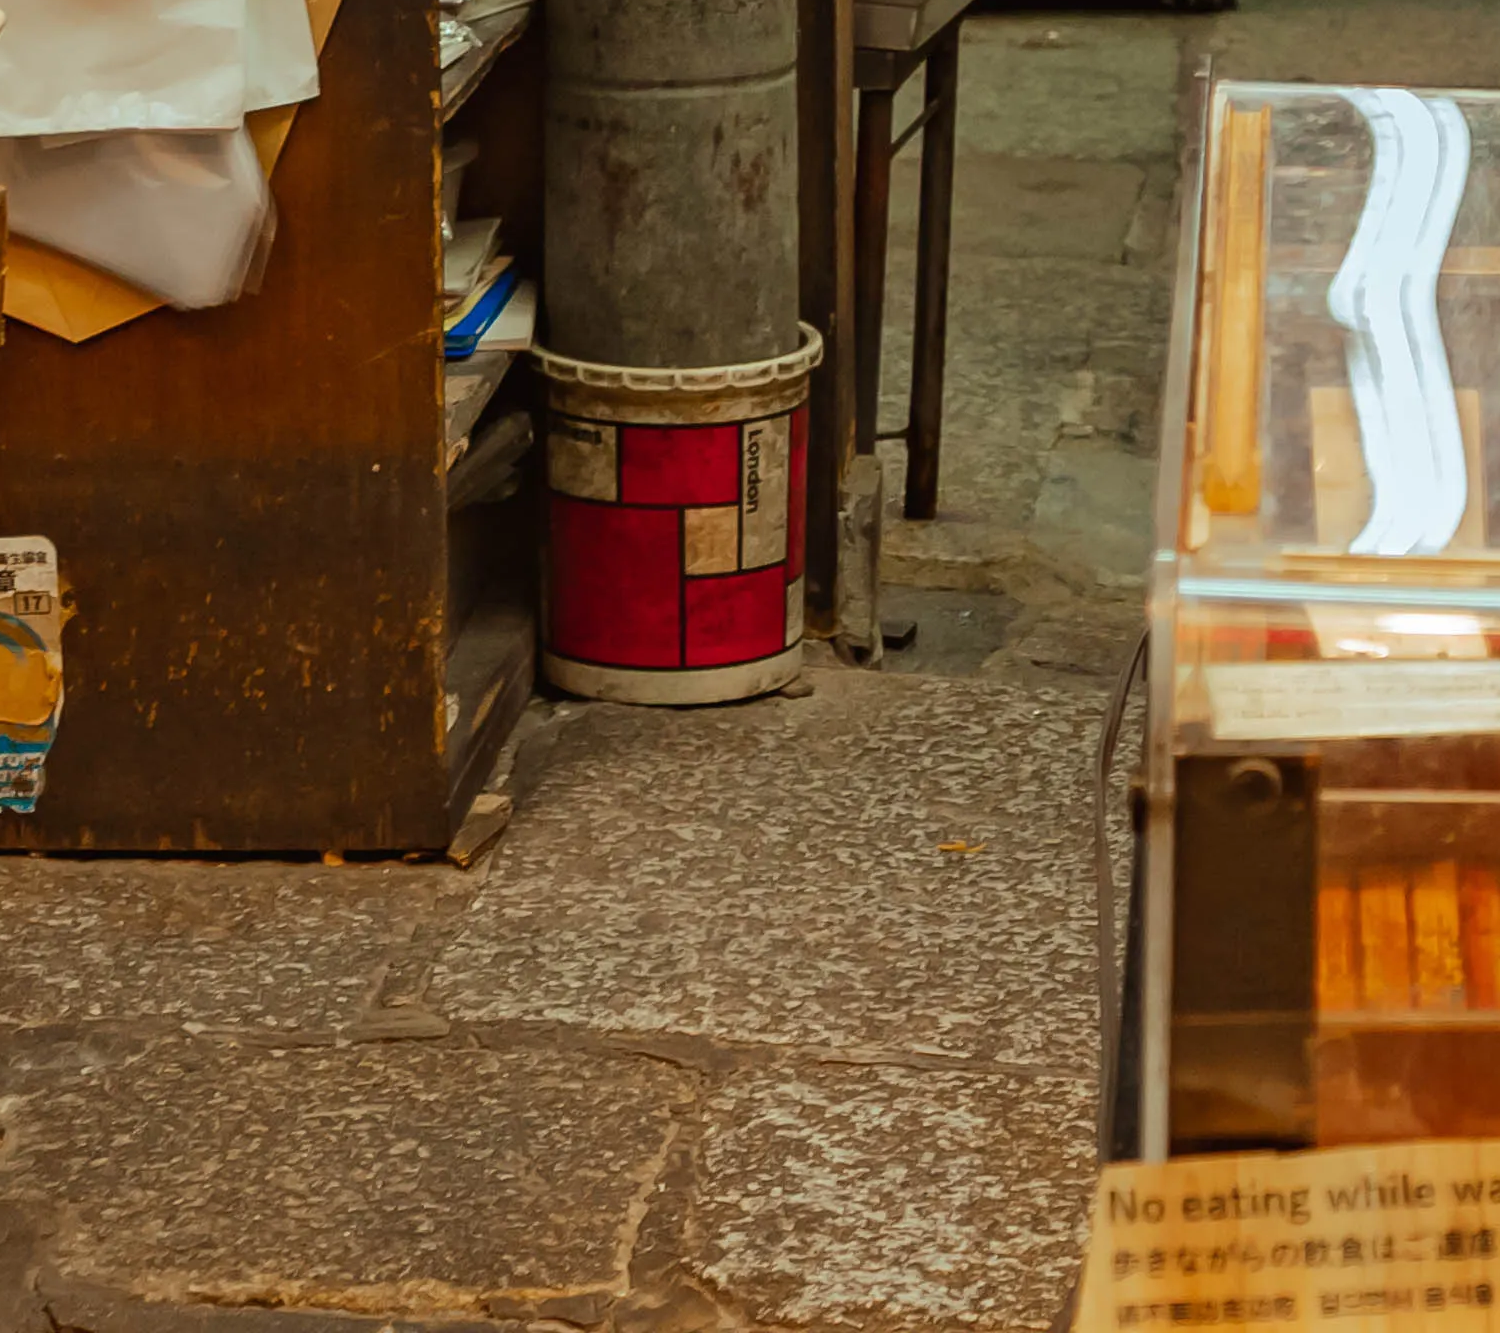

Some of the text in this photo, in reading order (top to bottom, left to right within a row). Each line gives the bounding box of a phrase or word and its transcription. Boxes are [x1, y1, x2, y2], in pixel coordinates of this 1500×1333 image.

[745, 428, 765, 515] London
[22, 595, 43, 611] 17
[1108, 1189, 1164, 1225] No
[1183, 1183, 1312, 1226] eating
[1326, 1173, 1436, 1215] while
